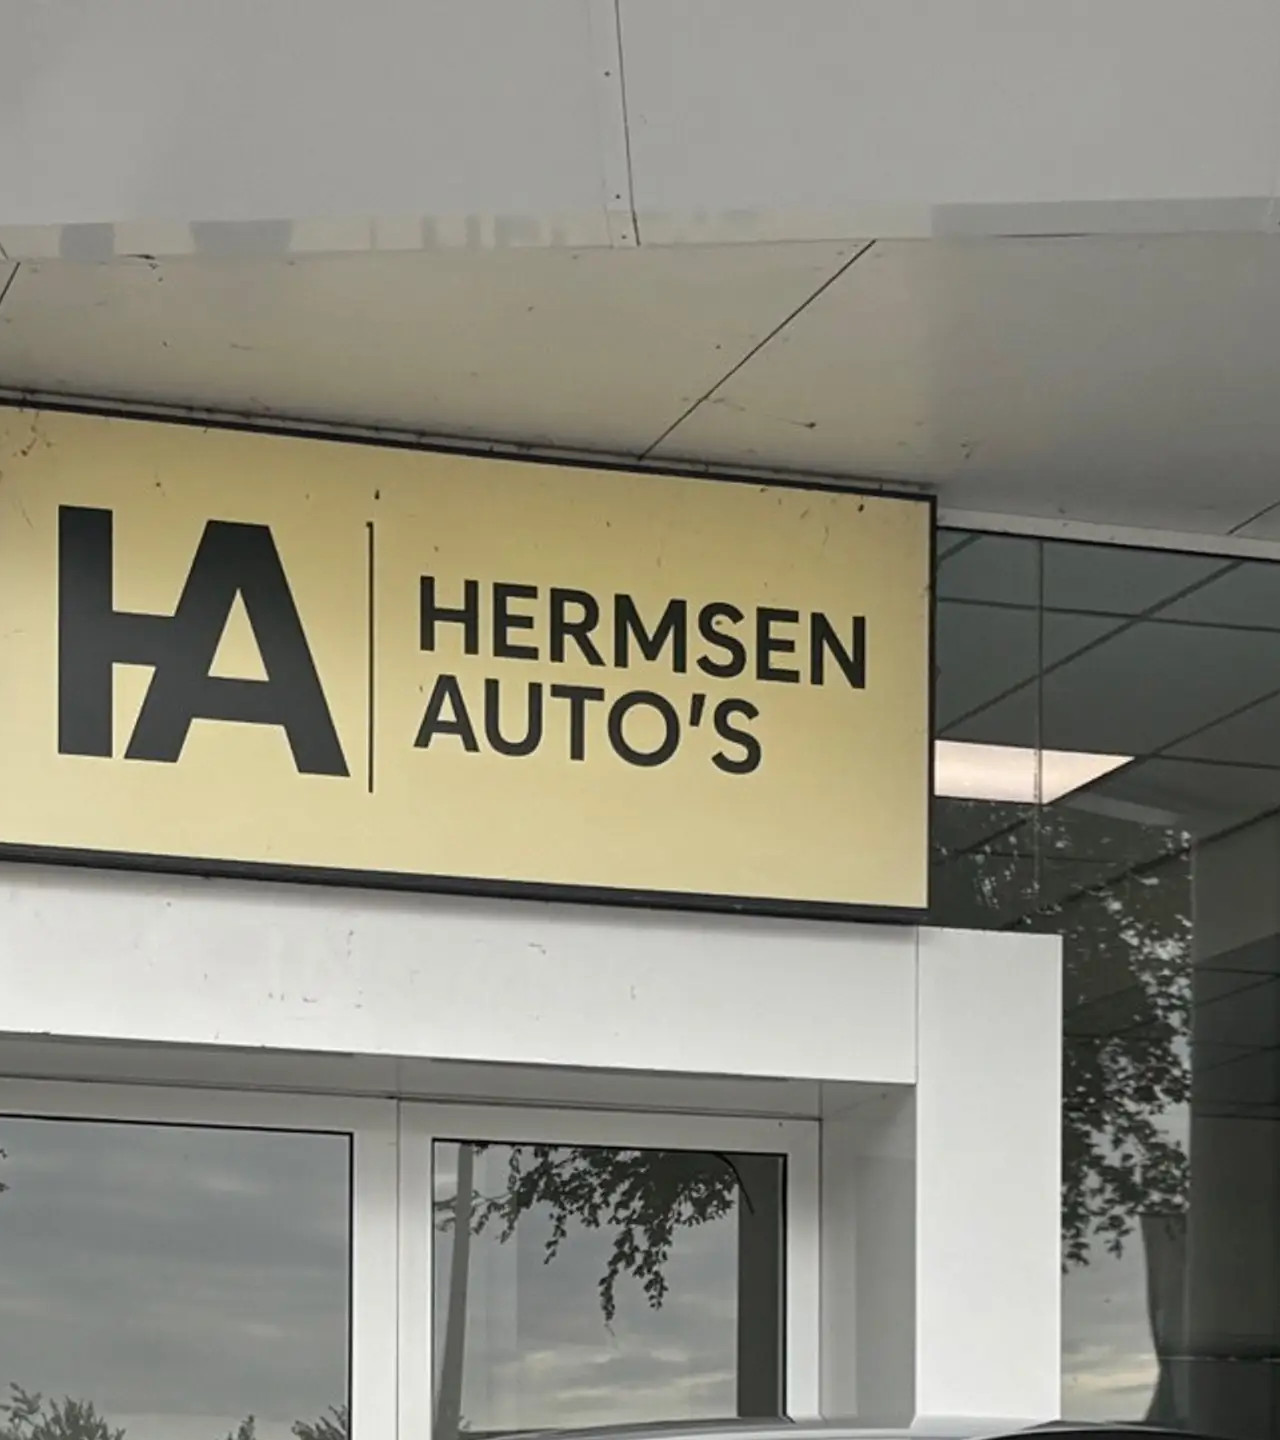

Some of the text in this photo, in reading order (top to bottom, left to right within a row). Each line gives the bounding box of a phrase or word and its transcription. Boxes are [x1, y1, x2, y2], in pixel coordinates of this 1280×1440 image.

[58, 504, 351, 777] HA
[419, 575, 867, 690] HERMSEN
[414, 673, 762, 775] AUTO'S
